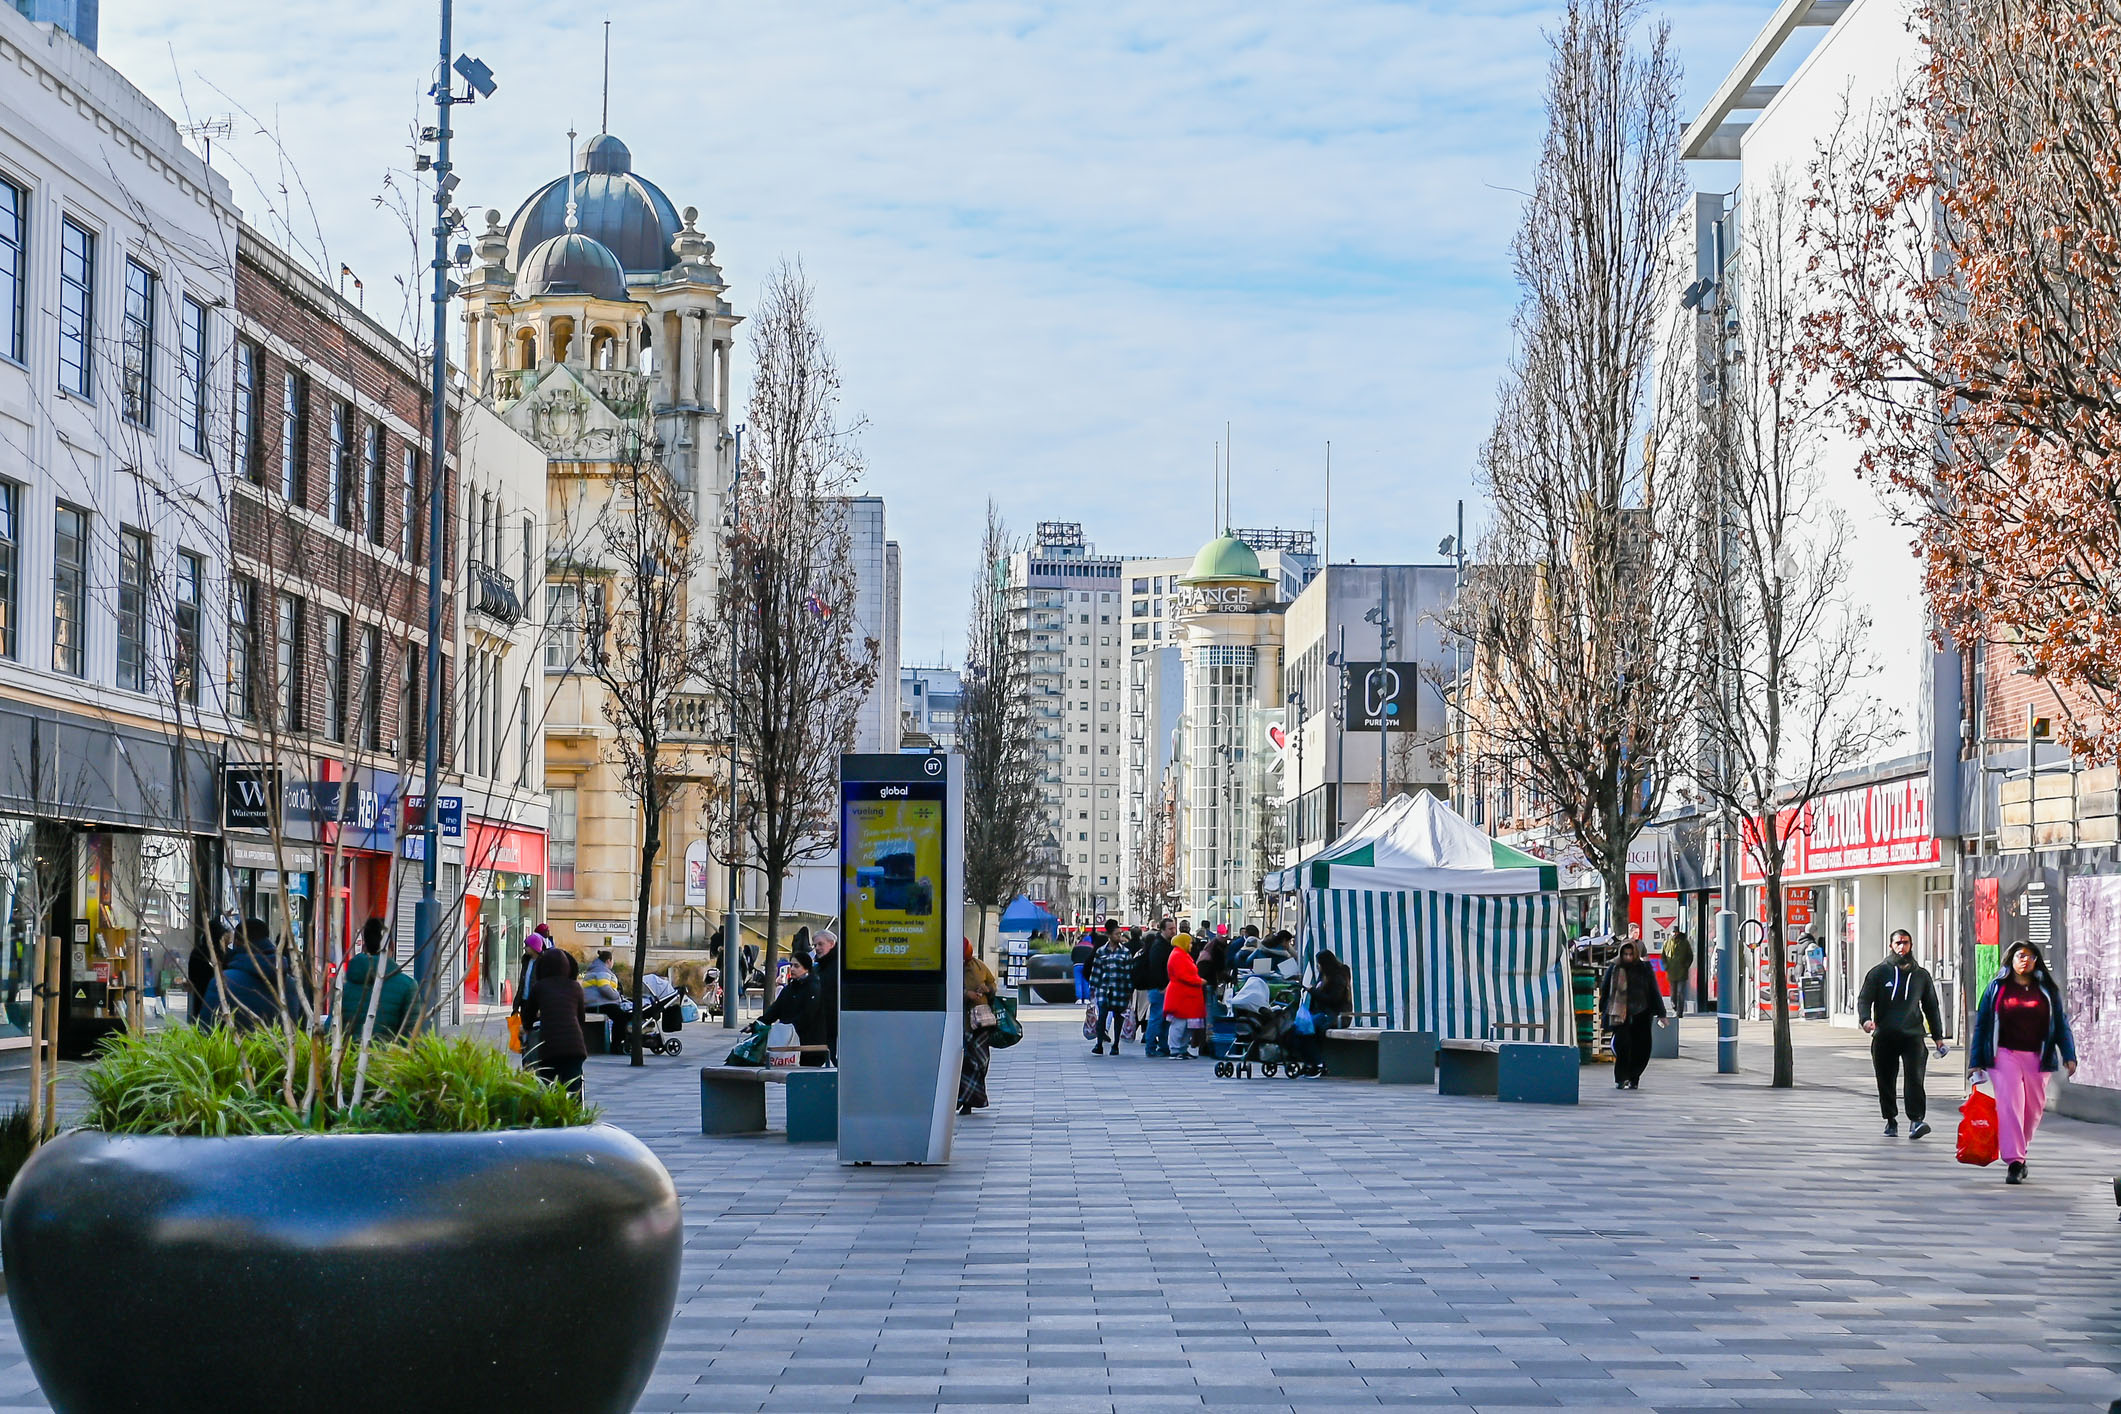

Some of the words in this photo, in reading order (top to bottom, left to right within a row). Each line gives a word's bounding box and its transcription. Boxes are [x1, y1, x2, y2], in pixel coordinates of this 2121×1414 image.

[1218, 605, 1248, 613] ILFORD
[236, 781, 272, 807] W
[880, 786, 908, 798] global
[852, 807, 884, 817] vueling
[1809, 787, 1869, 850] FACTORY
[1870, 777, 1929, 844] OUTLET
